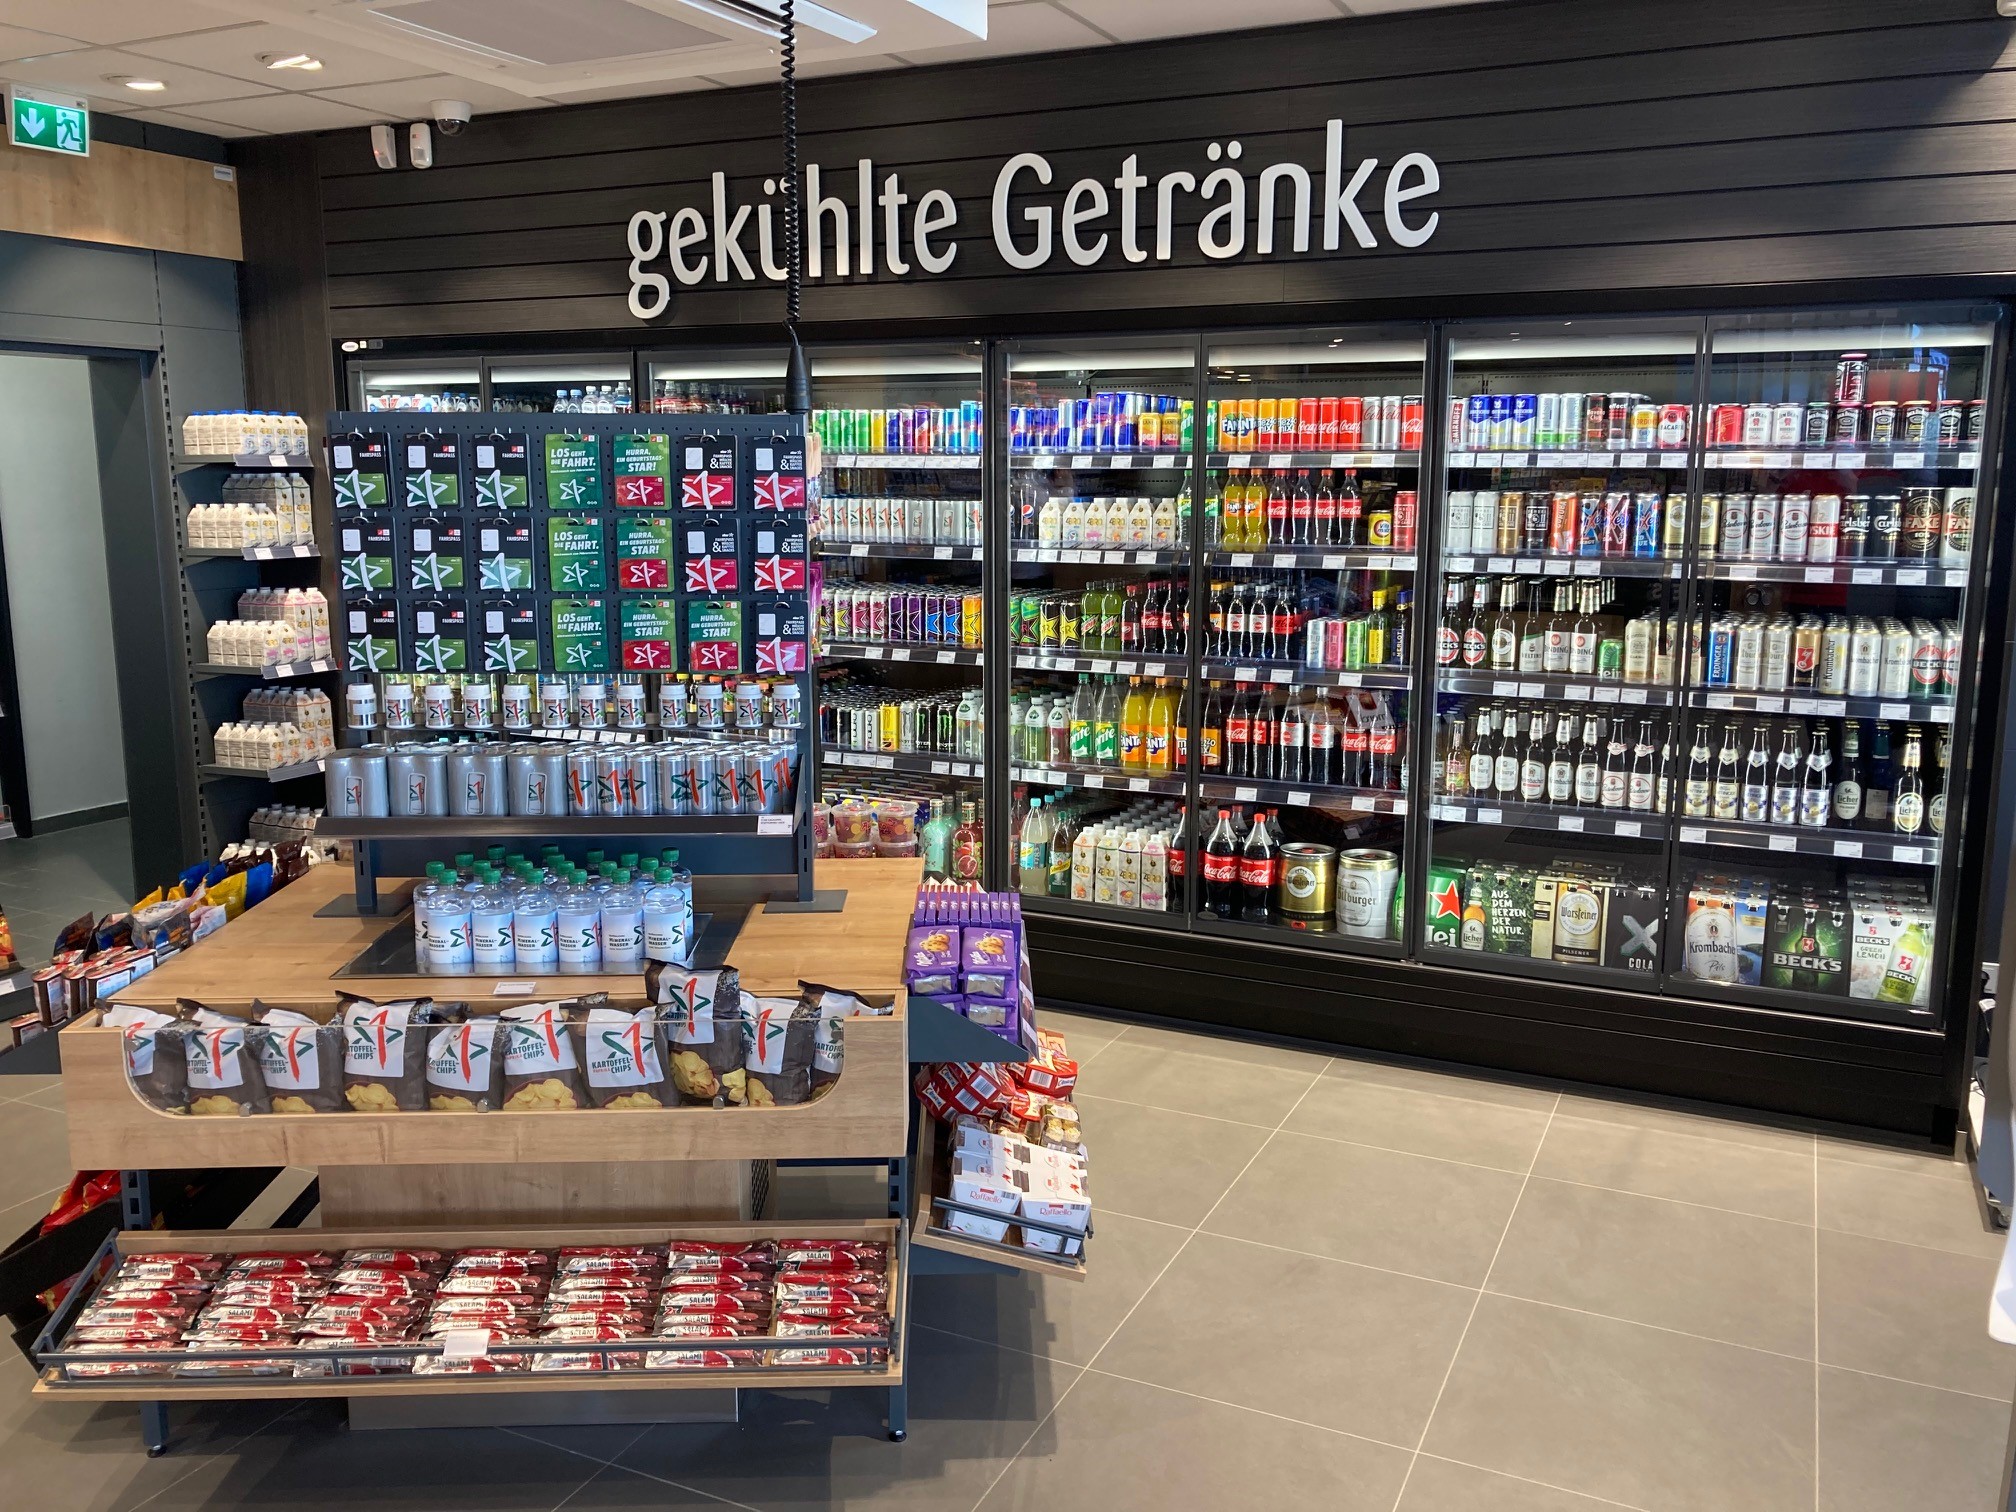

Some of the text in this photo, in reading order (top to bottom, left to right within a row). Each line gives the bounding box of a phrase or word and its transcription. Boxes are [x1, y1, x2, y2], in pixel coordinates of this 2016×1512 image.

[627, 119, 1441, 319] gekühlte Getränke
[1452, 407, 1462, 444] SMIRNOFF
[550, 448, 570, 458] LOS
[562, 457, 596, 467] FAHRT.
[628, 462, 656, 472] STAR!
[710, 458, 719, 469] &
[780, 459, 790, 470] &
[1906, 517, 1939, 528] FAXE
[554, 532, 573, 541] LOS
[565, 541, 599, 551] FAHRT.
[631, 545, 659, 555] STAR!
[712, 541, 722, 553] &
[781, 541, 791, 553] &
[557, 613, 576, 623] LOS
[568, 622, 602, 632] FAHRT.
[635, 627, 663, 637] STAR!
[783, 624, 792, 635] &
[702, 628, 731, 638] STAR!
[1396, 629, 1404, 658] MERLOT
[1463, 642, 1486, 650] BECK'S
[1712, 645, 1723, 678] ERDINGER
[1827, 639, 1836, 680] Krombacher
[1121, 737, 1141, 747] ANTA
[1147, 738, 1166, 749] ANTA
[1837, 794, 1859, 804] Licher
[1204, 864, 1237, 879] Coca-Cola
[1492, 890, 1509, 899] AUS
[1492, 899, 1513, 908] DEM
[1492, 908, 1526, 917] HERZEN
[1560, 905, 1597, 921] Warsteiner
[1492, 917, 1510, 926] DER
[1492, 926, 1525, 936] NATUR.
[1463, 933, 1482, 943] Licher
[1856, 936, 1890, 945] BECK'S
[1562, 948, 1590, 956] PILSENER
[1856, 950, 1886, 960] LEMON
[1628, 957, 1654, 971] COLA
[1704, 960, 1725, 972] Pils
[1773, 953, 1843, 972] BECK'S
[1886, 971, 1917, 984] BECK'S
[353, 1052, 374, 1060] CHIPS
[523, 1050, 545, 1059] CHIPS
[592, 1056, 633, 1068] KARTOFFEL-
[270, 1066, 287, 1074] CHIPS
[436, 1066, 457, 1074] CHIPS
[611, 1064, 632, 1074] CHIPS
[970, 1191, 1002, 1204] Raffaello
[1040, 1207, 1072, 1216] Raffaello
